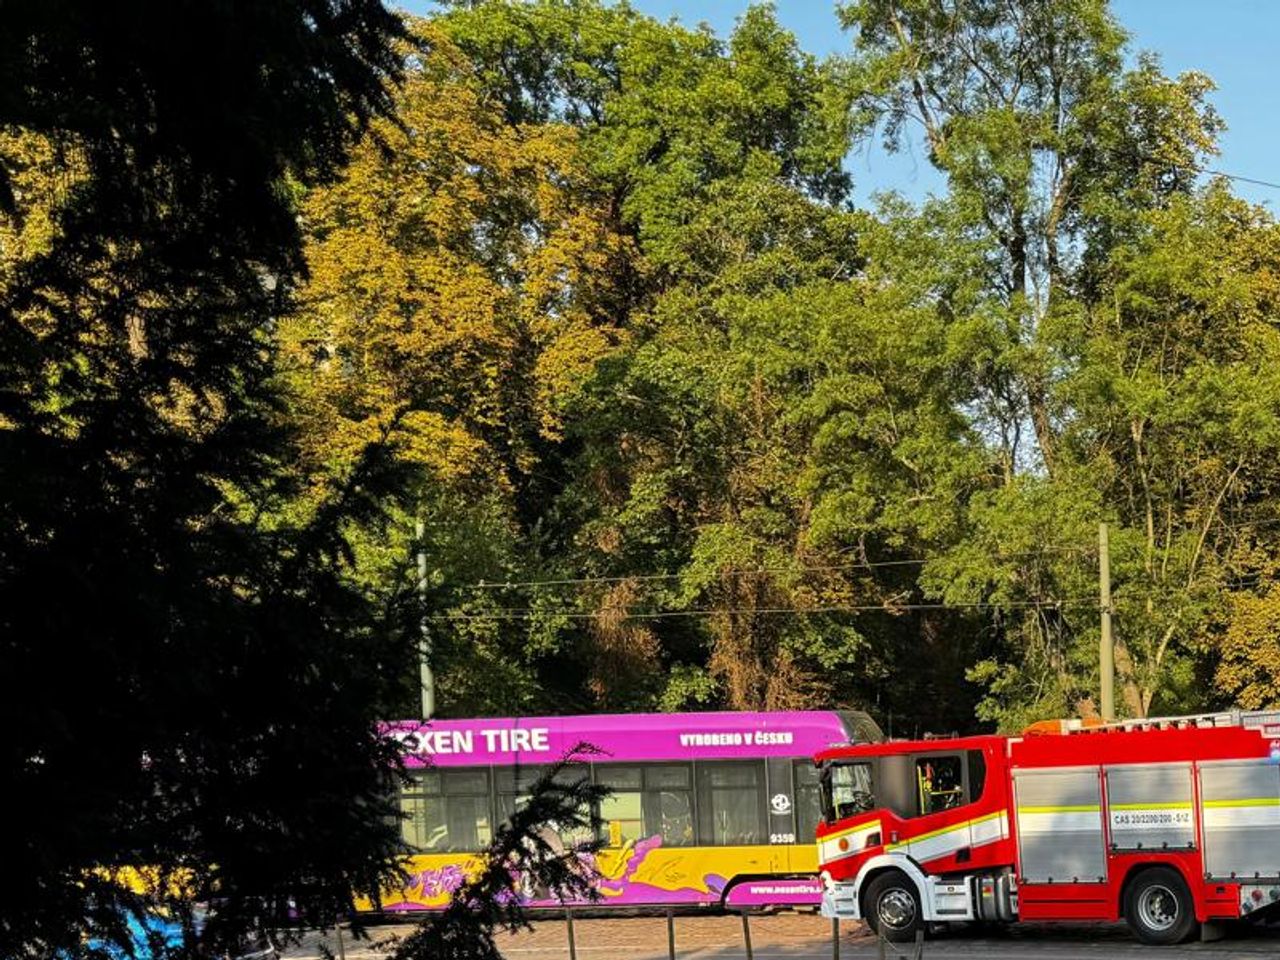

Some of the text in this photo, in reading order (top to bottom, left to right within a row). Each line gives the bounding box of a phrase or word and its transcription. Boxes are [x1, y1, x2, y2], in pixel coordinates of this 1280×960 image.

[481, 728, 550, 752] TIRE
[680, 730, 793, 746] VYROBENO V ČESKU
[1114, 815, 1130, 824] CAS
